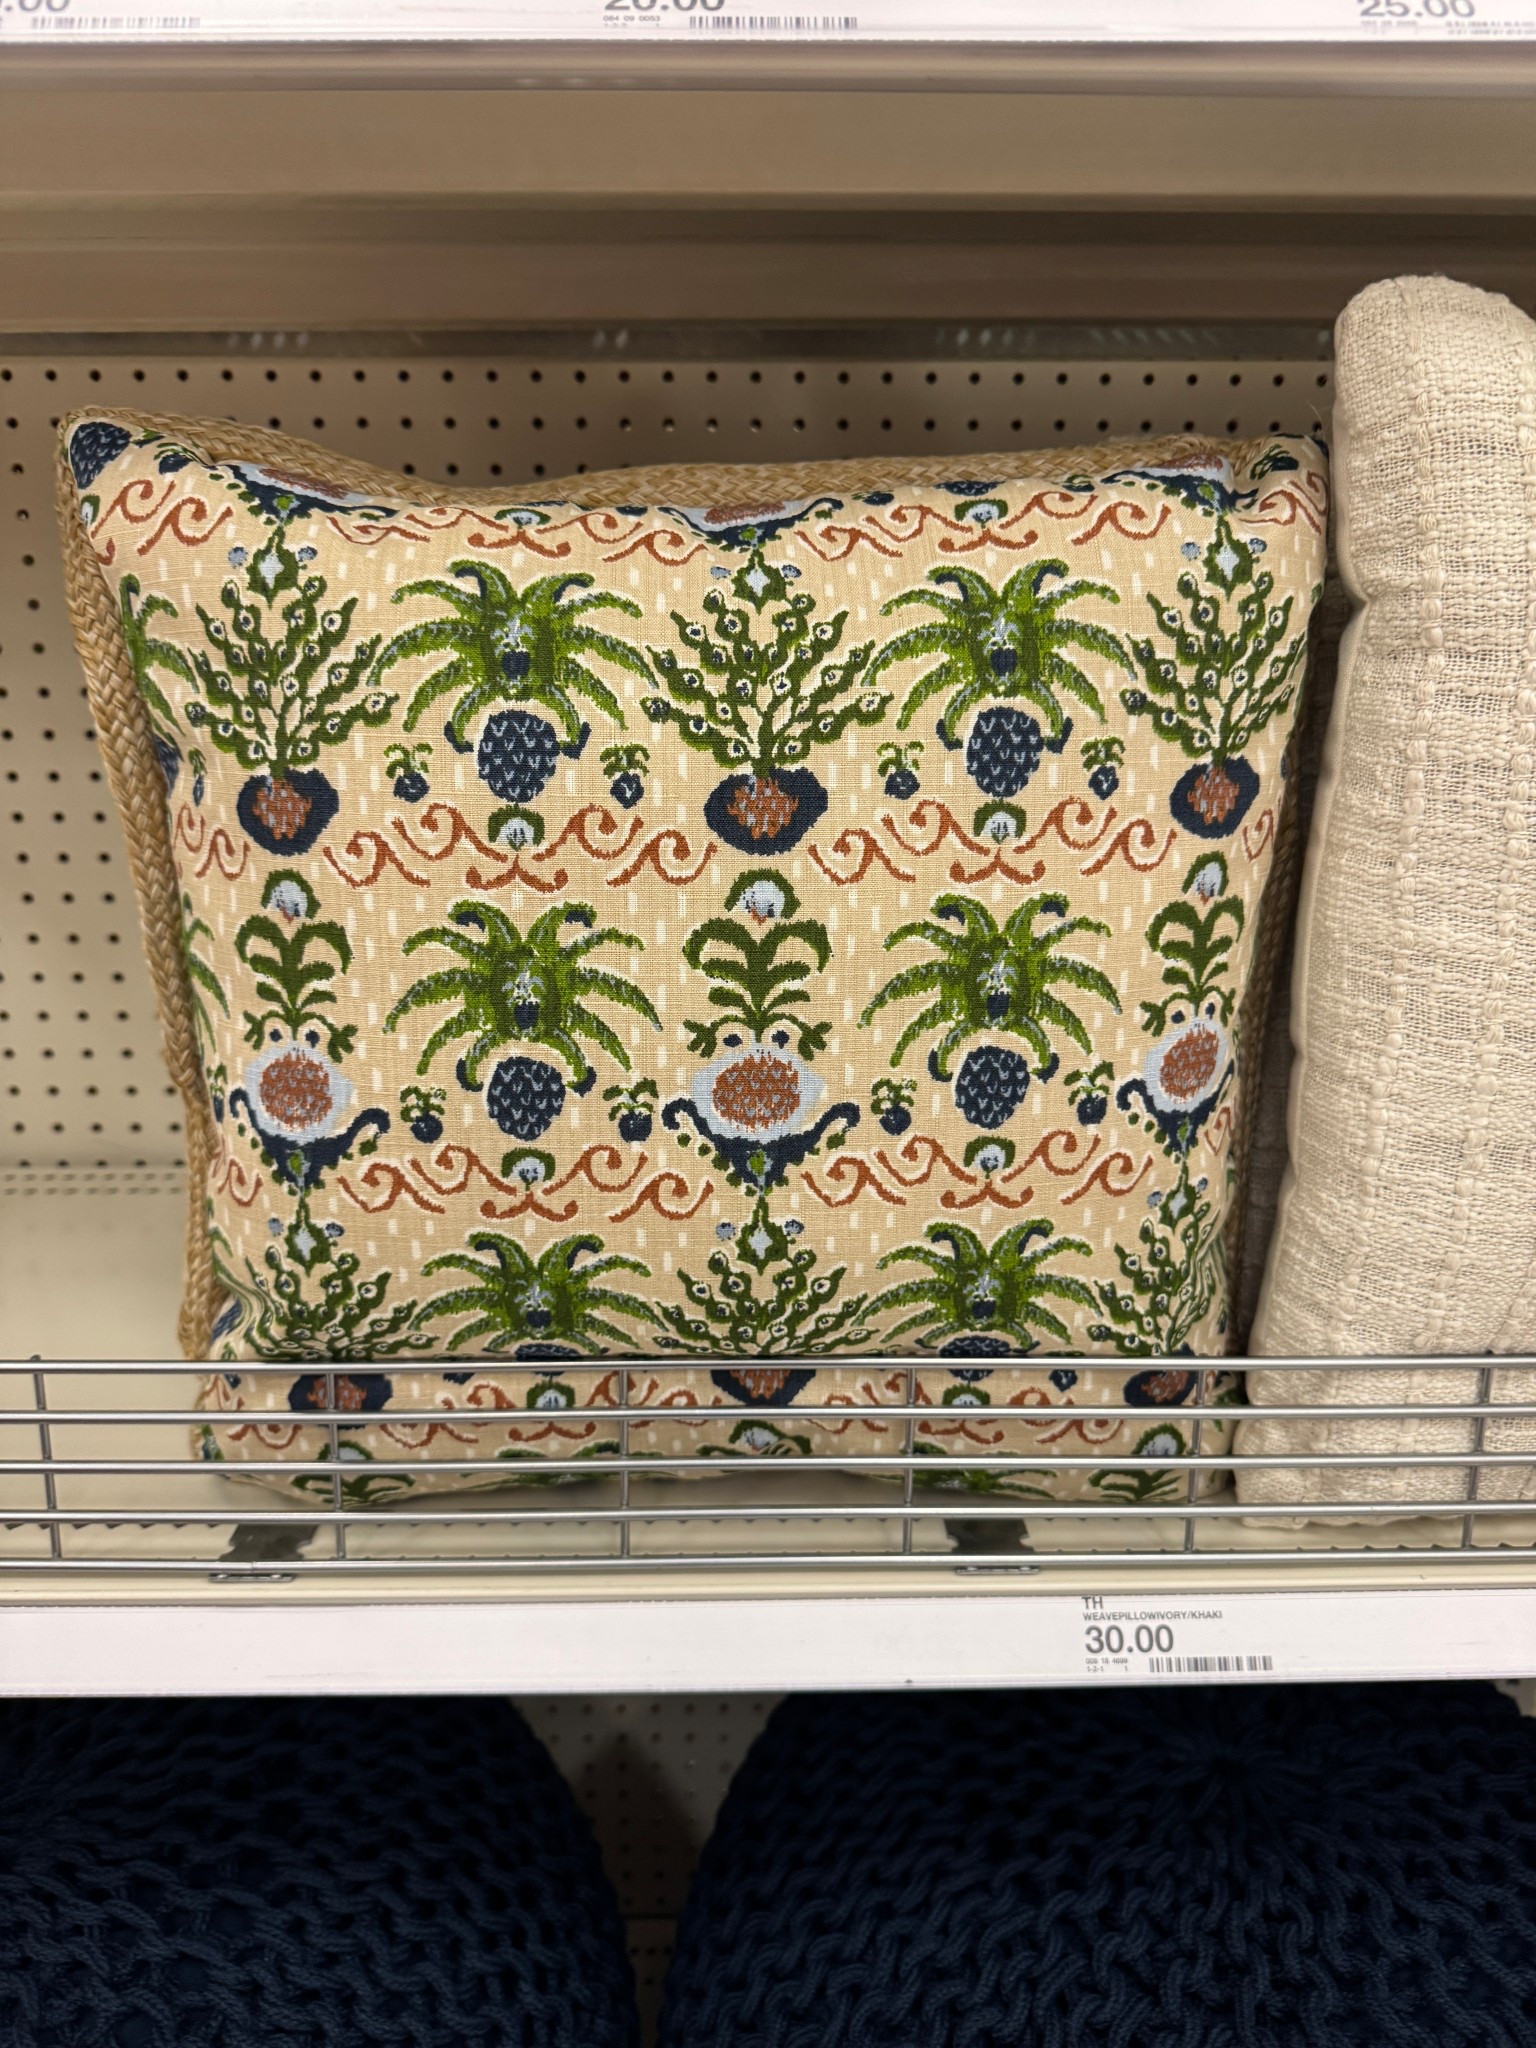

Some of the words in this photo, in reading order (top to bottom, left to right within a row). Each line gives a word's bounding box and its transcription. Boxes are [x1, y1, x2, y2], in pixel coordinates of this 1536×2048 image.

[1357, 0, 1475, 17] 25.00
[1082, 1596, 1103, 1609] TH
[1083, 1610, 1223, 1621] WEAVEPILLOWIVORY/KHAKI
[1085, 1624, 1174, 1654] 30.00
